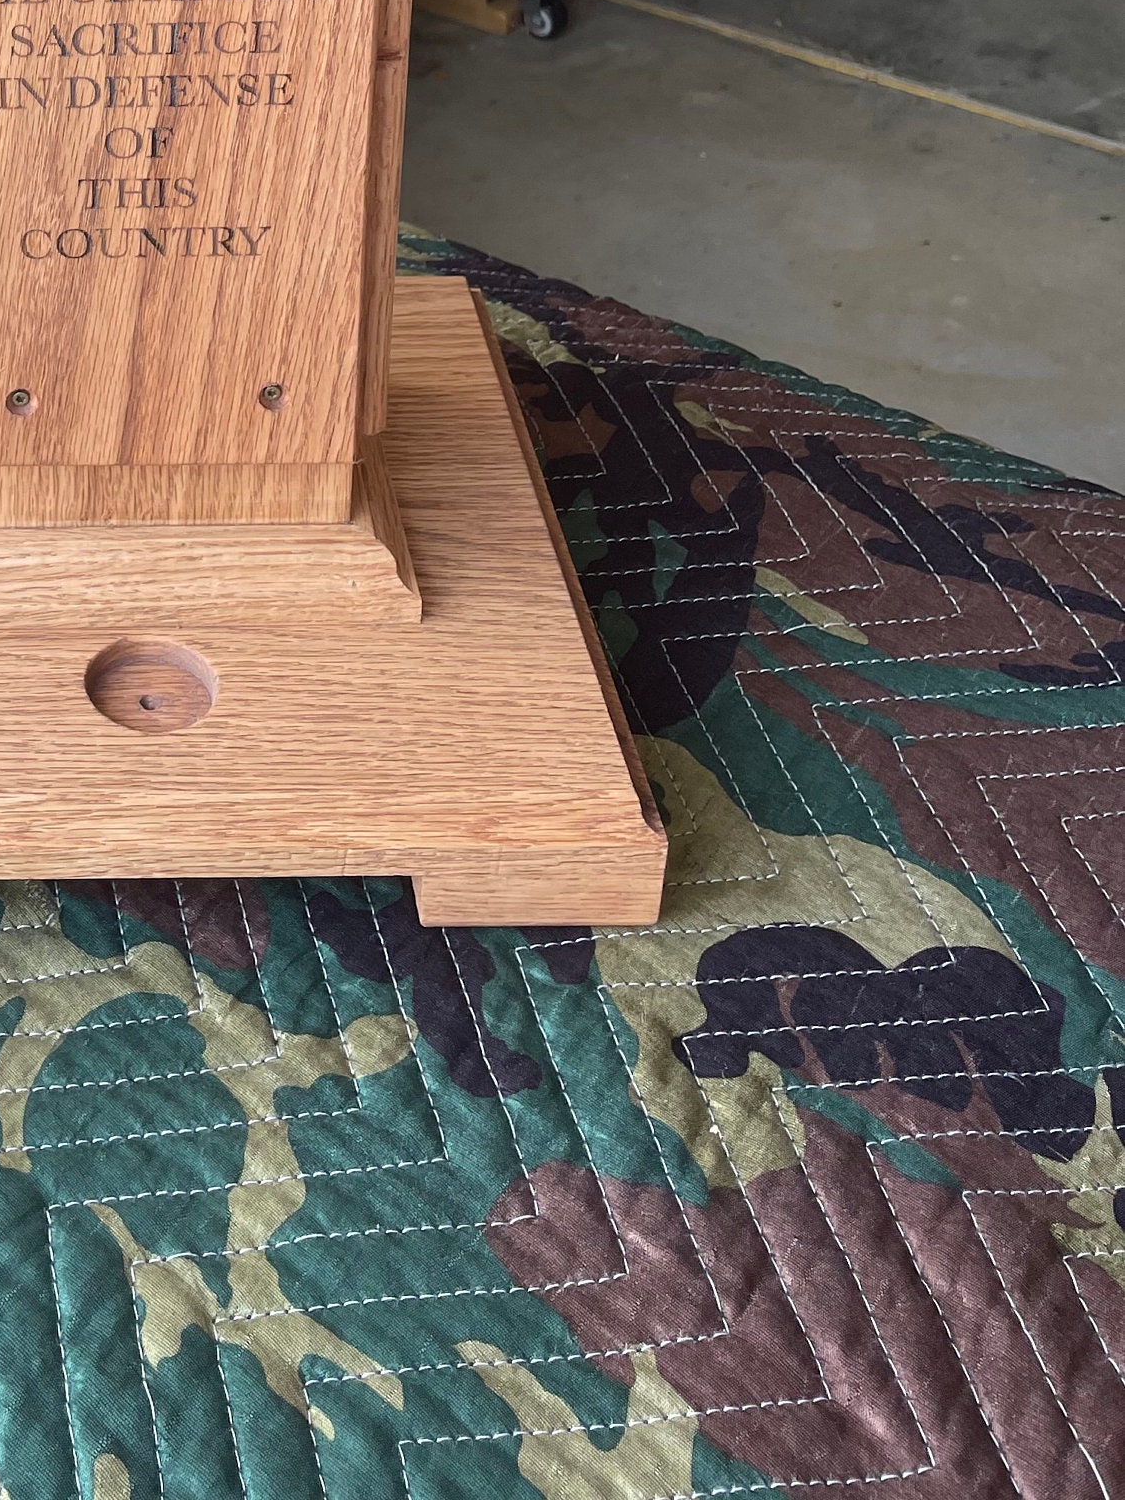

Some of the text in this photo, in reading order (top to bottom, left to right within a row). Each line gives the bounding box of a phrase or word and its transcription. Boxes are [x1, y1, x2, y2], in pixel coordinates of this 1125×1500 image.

[10, 20, 283, 59] SACRIFICE
[65, 73, 296, 110] DEFENSE
[103, 126, 176, 160] OF
[77, 176, 198, 210] THIS
[20, 225, 272, 260] COUNTRY
